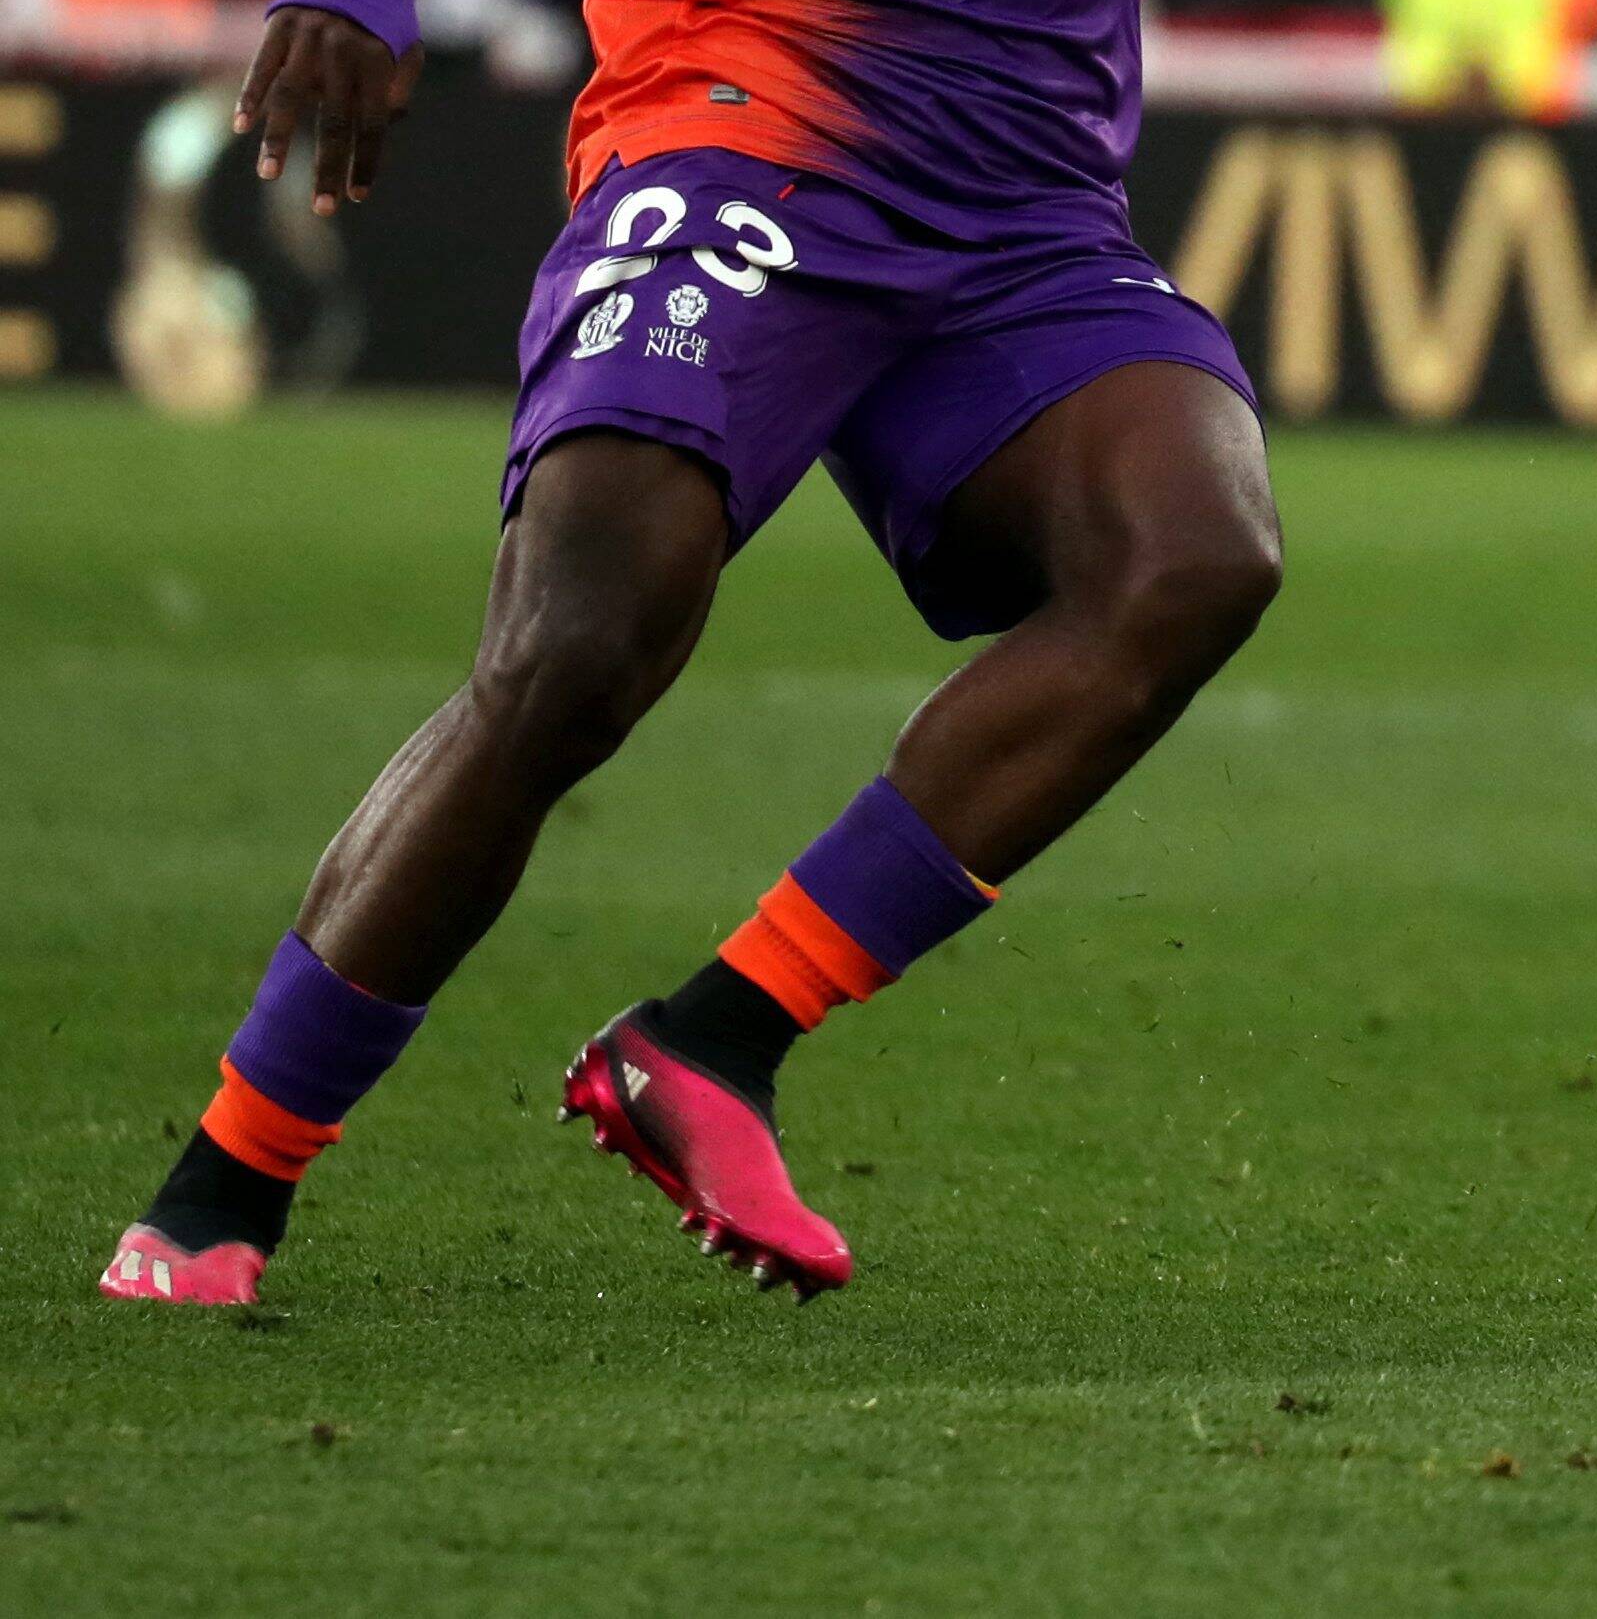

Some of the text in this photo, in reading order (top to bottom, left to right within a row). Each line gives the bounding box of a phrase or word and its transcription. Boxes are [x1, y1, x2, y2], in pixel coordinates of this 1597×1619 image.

[575, 185, 799, 297] 23
[648, 327, 689, 340] VILLE
[643, 338, 706, 368] NICE
